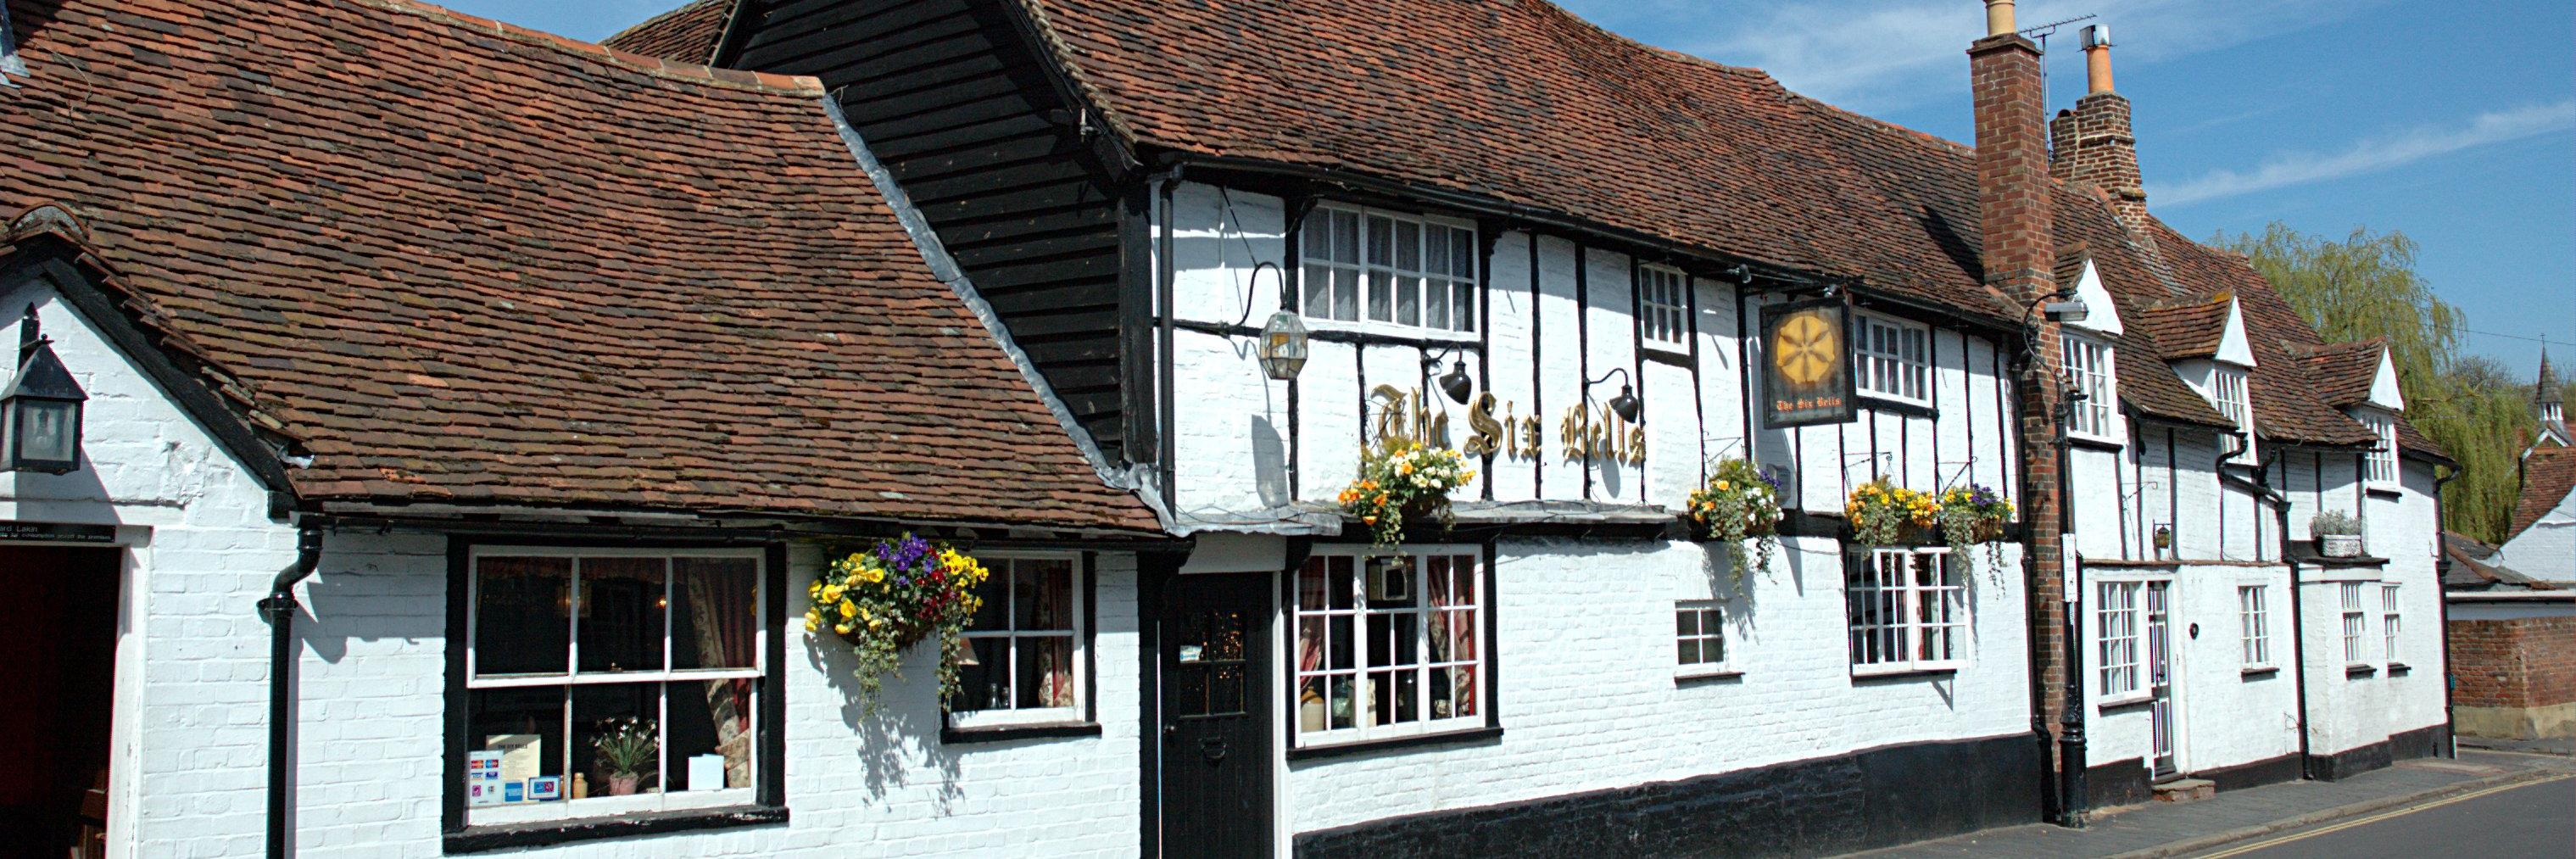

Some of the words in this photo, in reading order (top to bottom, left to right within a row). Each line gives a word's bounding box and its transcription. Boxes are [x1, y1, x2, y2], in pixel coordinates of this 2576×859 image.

[1370, 383, 1450, 450] The
[1464, 390, 1542, 457] Six
[1561, 401, 1647, 463] Bells
[1776, 400, 1794, 412] The
[1797, 398, 1814, 410] Six
[1816, 396, 1842, 408] Bells
